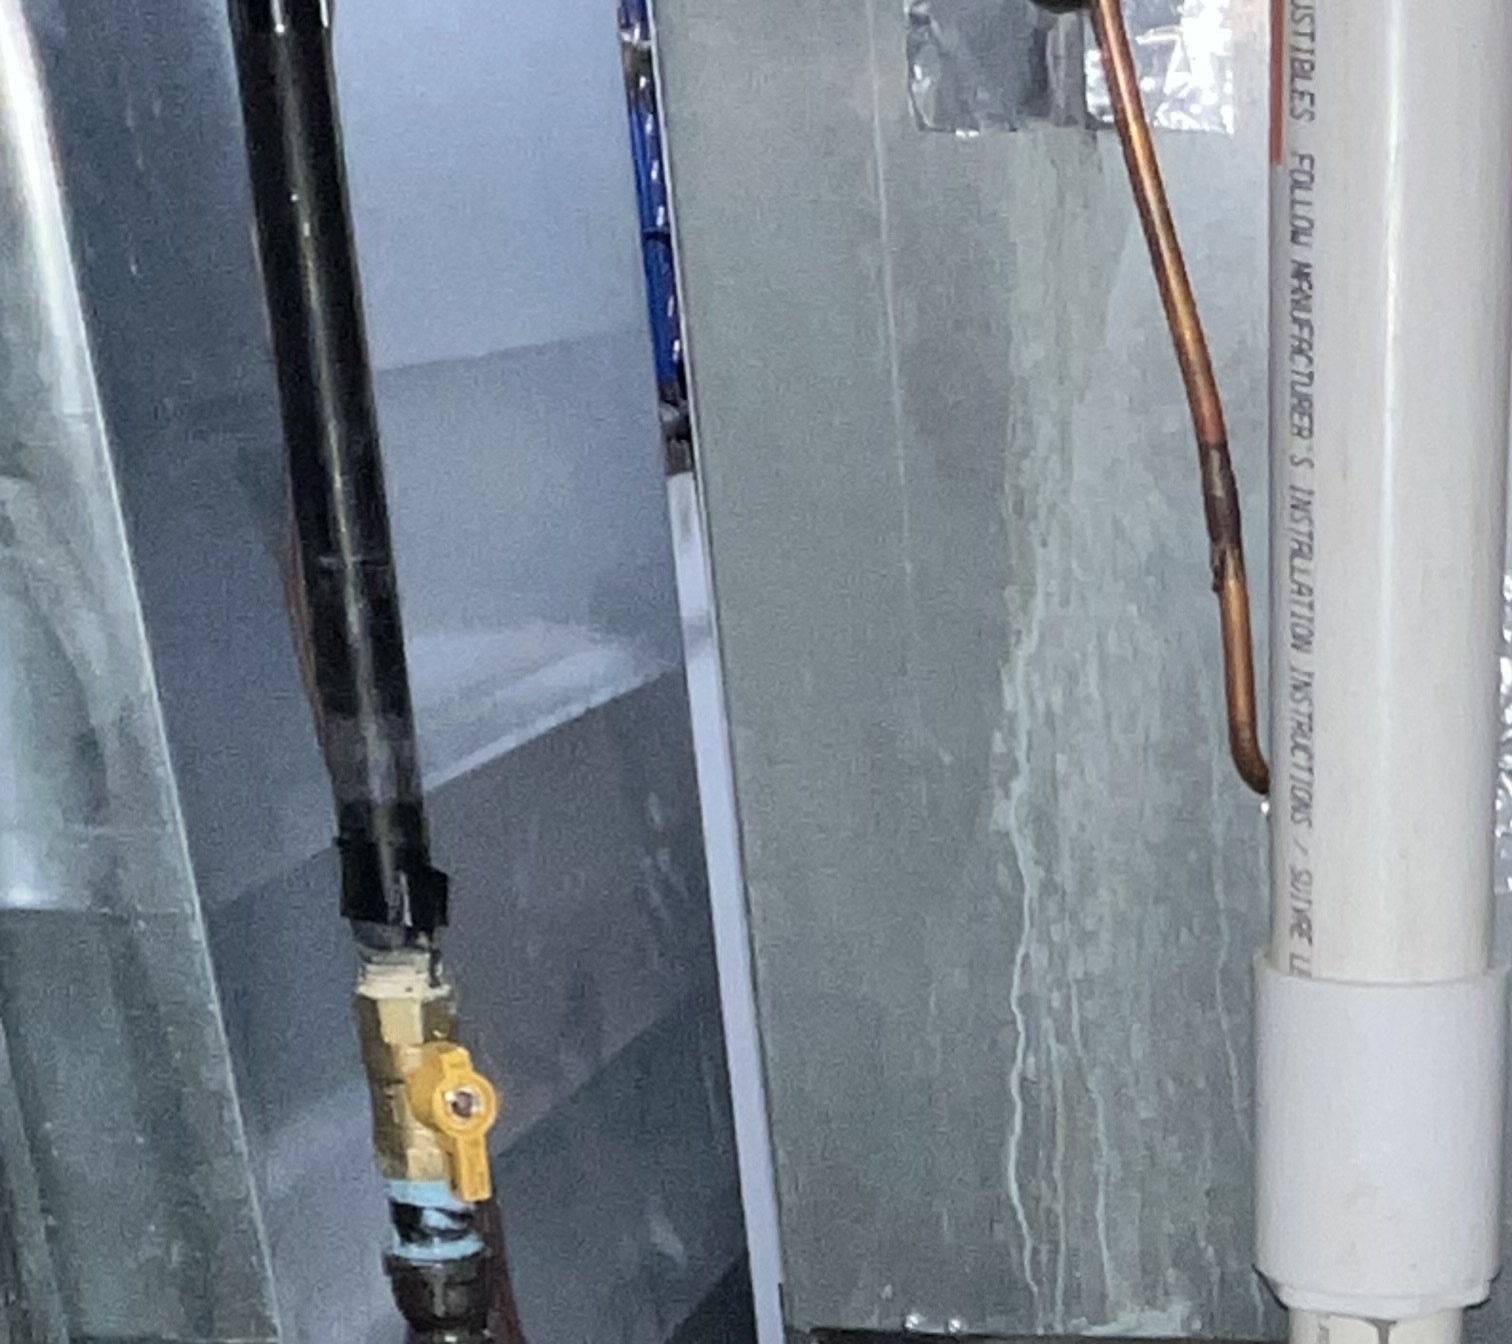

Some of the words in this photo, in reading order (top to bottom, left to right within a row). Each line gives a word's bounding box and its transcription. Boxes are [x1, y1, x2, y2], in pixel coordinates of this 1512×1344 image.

[1289, 150, 1316, 246] FOLLOW
[1288, 484, 1315, 653] INSTALLATION
[1289, 665, 1315, 829] INSTRUCTIONS
